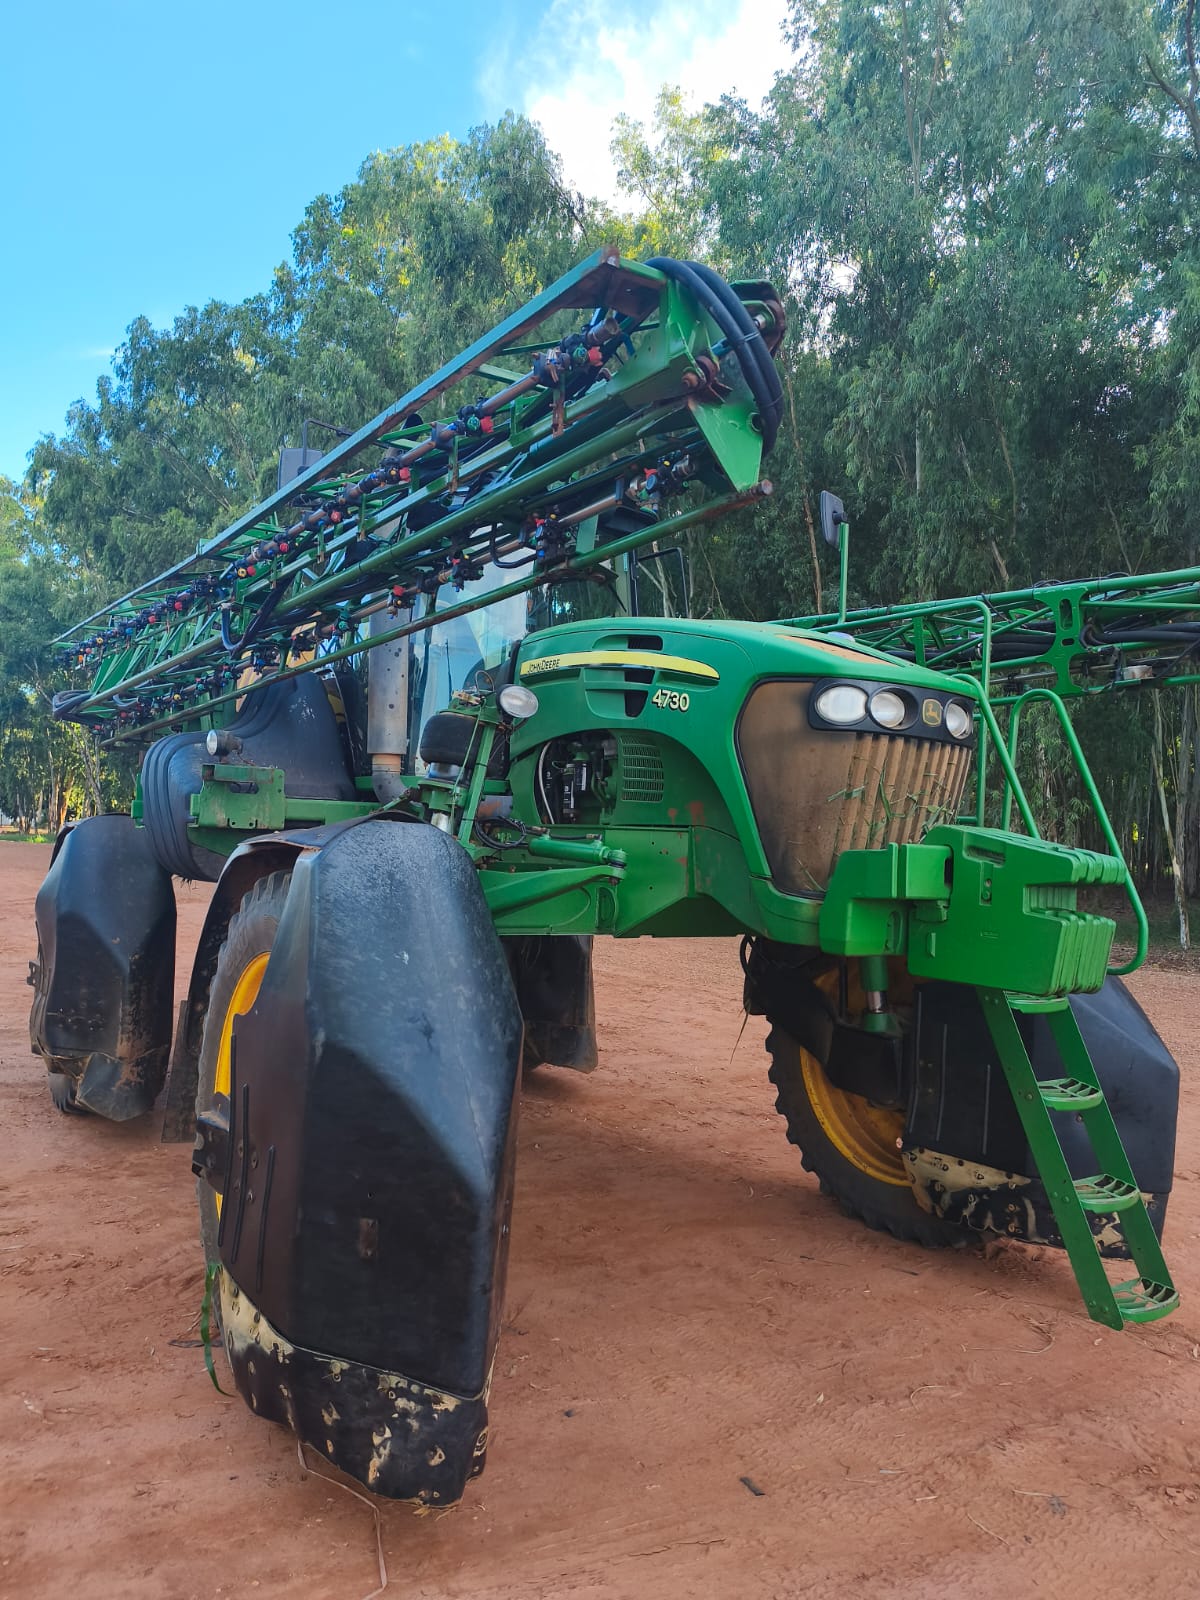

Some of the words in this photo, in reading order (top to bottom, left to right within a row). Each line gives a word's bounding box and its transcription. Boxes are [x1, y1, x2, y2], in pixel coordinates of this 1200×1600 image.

[527, 663, 541, 672] JOHN
[540, 658, 560, 670] DEERE
[652, 689, 690, 712] 4730
